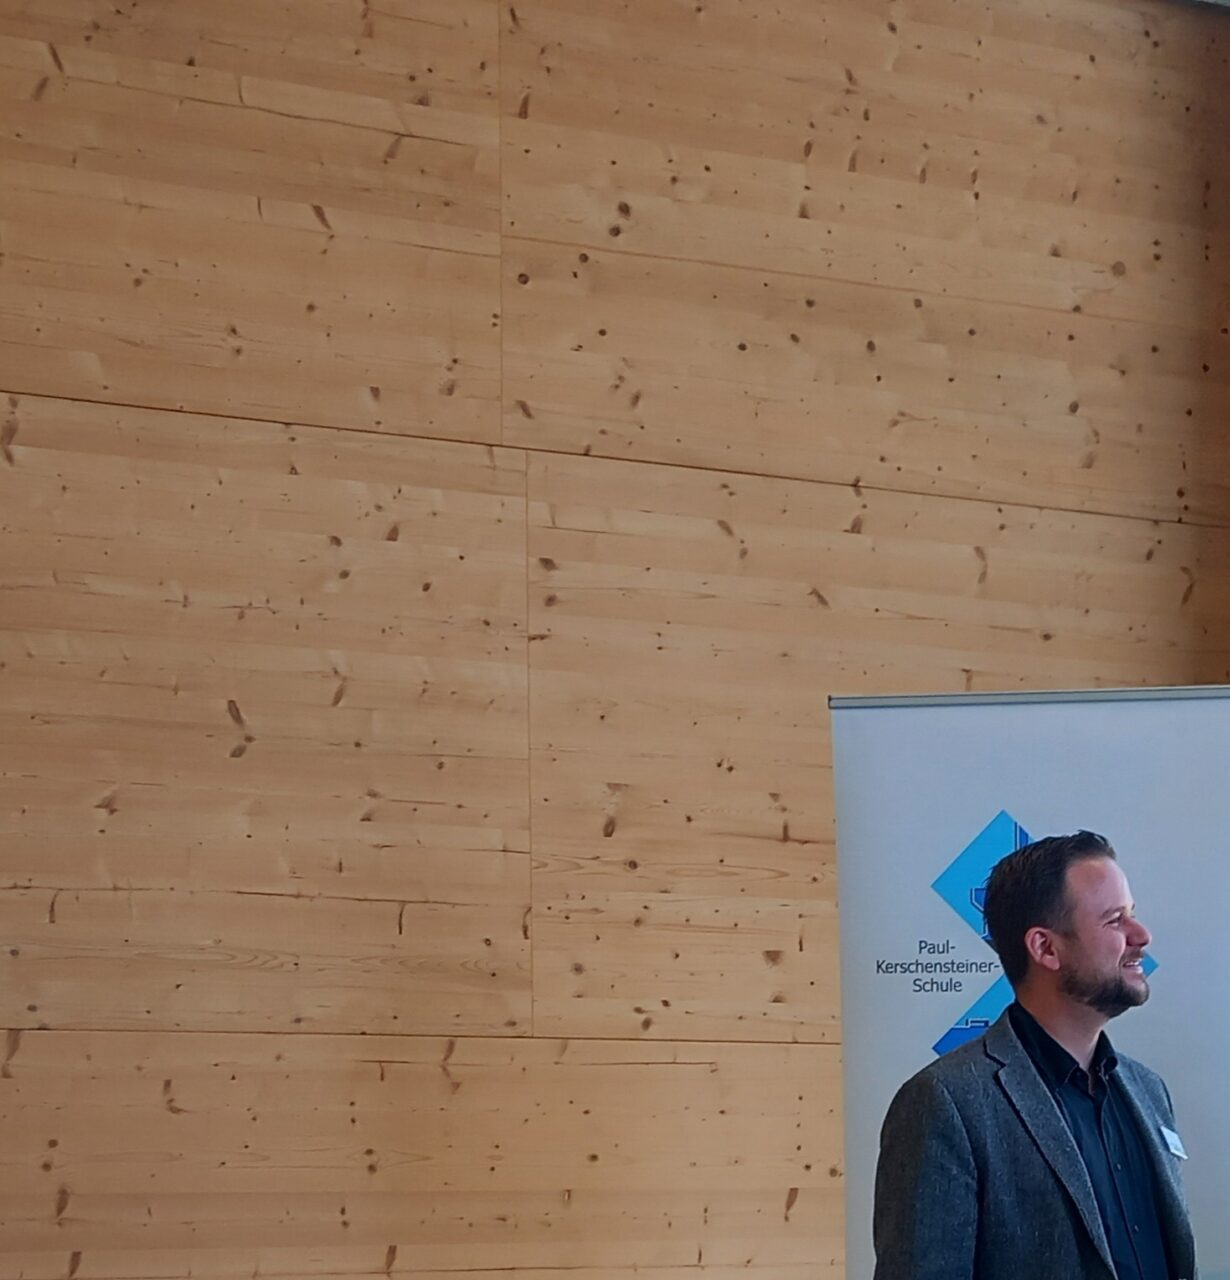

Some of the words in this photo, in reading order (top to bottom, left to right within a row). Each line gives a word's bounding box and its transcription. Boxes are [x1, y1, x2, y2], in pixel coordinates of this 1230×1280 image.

[918, 940, 956, 955] Paul-
[876, 959, 1000, 975] Kerschensteiner-
[912, 978, 963, 993] Schule
